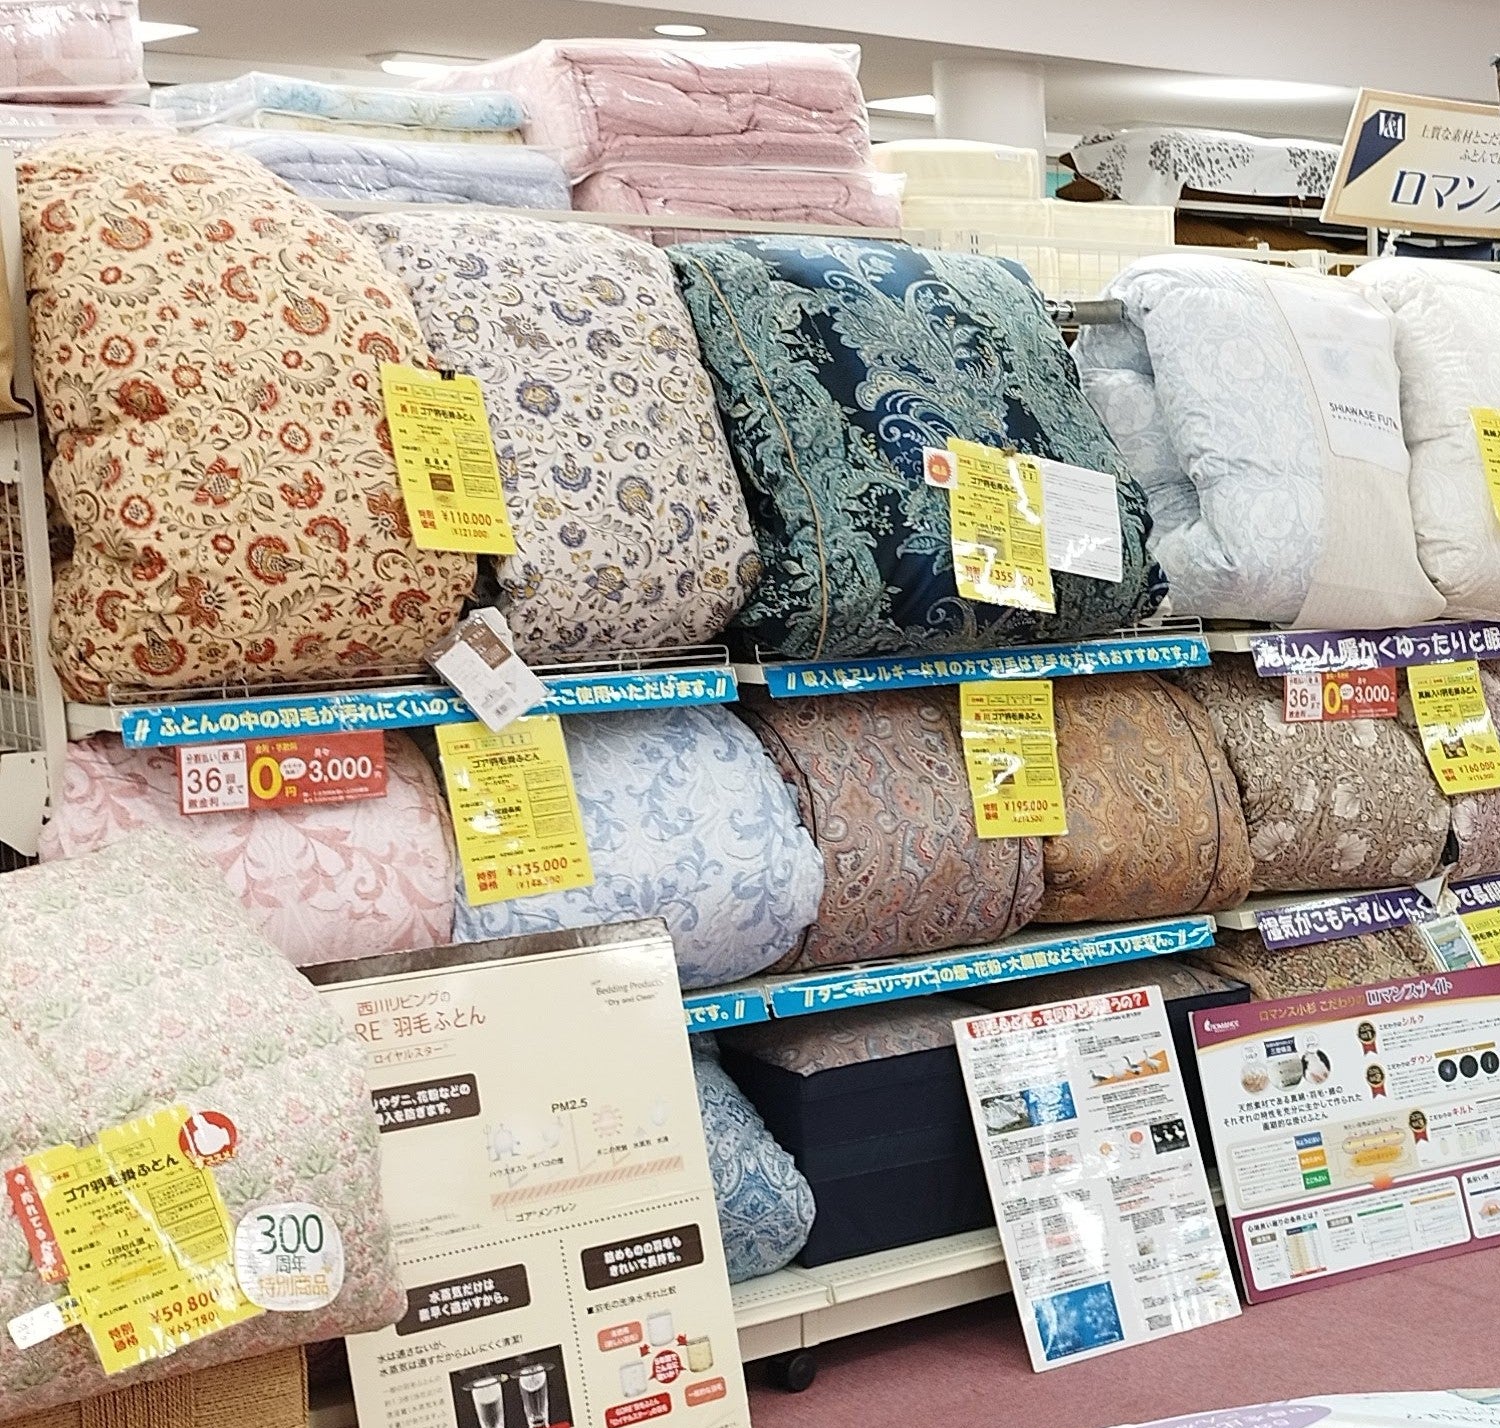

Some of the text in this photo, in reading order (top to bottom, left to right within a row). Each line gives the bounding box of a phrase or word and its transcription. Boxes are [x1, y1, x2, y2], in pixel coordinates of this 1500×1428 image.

[1289, 688, 1309, 707] 36
[1323, 681, 1342, 715] 0
[1354, 684, 1391, 704] 3,000
[186, 766, 223, 795] 36
[249, 756, 283, 800] 0
[308, 755, 373, 784] 3,000
[356, 991, 451, 1016] 西川リビングの
[1365, 977, 1454, 1006] ロマンスナイト
[393, 1006, 487, 1039] 羽毛ふとん
[550, 1097, 589, 1114] PM2.5
[62, 1153, 180, 1204] ゴア羽毛掛ふとん
[256, 1213, 324, 1255] 300
[275, 1254, 307, 1274] 周年
